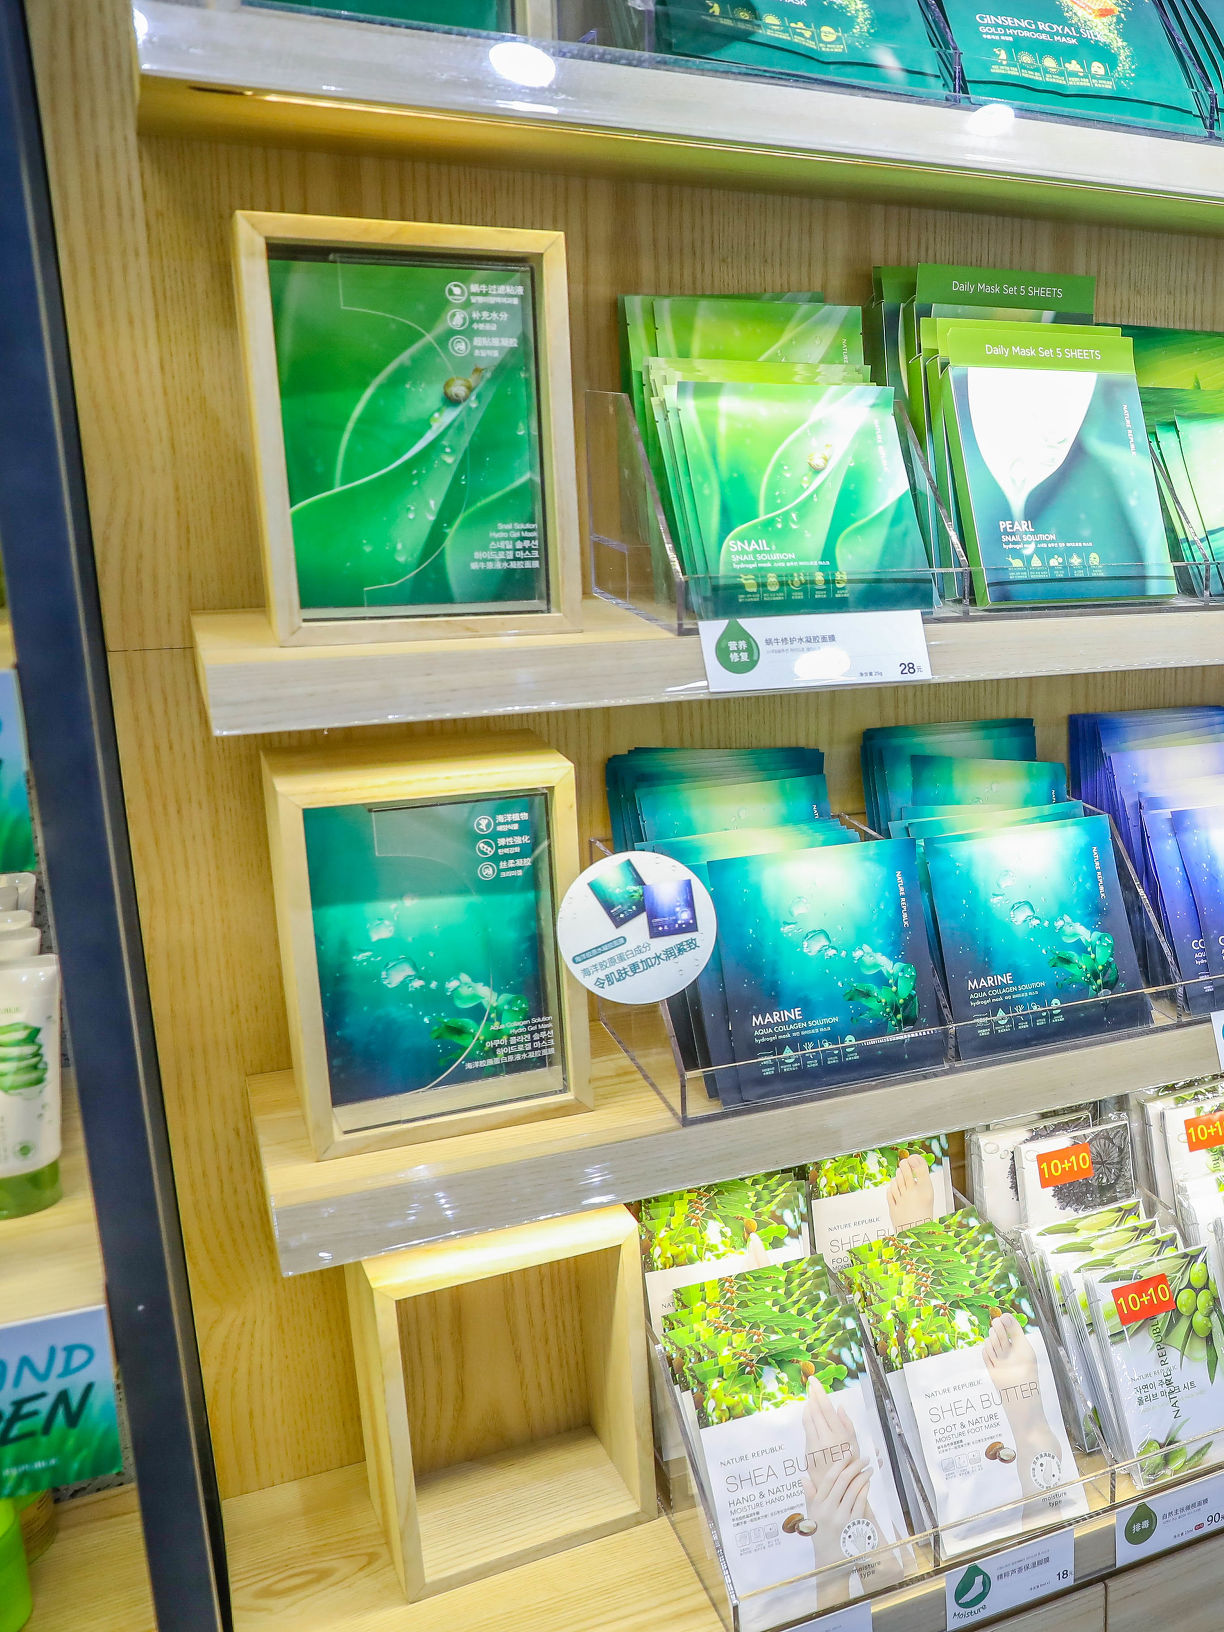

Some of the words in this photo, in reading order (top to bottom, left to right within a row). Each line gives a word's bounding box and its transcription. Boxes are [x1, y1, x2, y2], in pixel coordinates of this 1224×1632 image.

[976, 13, 1036, 31] GINSENG
[1037, 21, 1080, 37] ROYAL
[979, 26, 1005, 36] GOLD
[1006, 29, 1054, 42] HYDROGEL
[1054, 36, 1079, 46] MASK
[952, 281, 975, 294] Daily
[977, 283, 1001, 295] Mask
[1002, 284, 1018, 296] Set
[1020, 286, 1026, 296] 5
[1028, 286, 1063, 298] SHEETS
[985, 344, 1009, 357] Daily
[1012, 346, 1036, 358] Mask
[1038, 347, 1054, 358] Set
[1056, 348, 1063, 358] 5
[1064, 348, 1101, 360] SHEETS
[999, 520, 1035, 533] PEARL
[728, 539, 770, 553] SNAIL
[594, 937, 700, 989] 令肌肤更加水润紧致
[967, 972, 1013, 991] MARINE
[970, 990, 987, 1000] AQUA
[988, 985, 1018, 996] COLLAGEN
[1018, 981, 1046, 992] SOLUTION
[752, 1007, 803, 1027] MARINE
[754, 1026, 773, 1037] AQUA
[774, 1021, 807, 1033] COLLAGEN
[808, 1016, 839, 1027] SOLUTION
[1040, 1152, 1090, 1179] 10+10
[1117, 1283, 1171, 1315] 10+10
[0, 1381, 96, 1446] EN
[928, 1398, 976, 1424] SHEA
[980, 1380, 1040, 1411] BUTTER
[933, 1424, 959, 1437] FOOT
[960, 1421, 966, 1431] &
[968, 1412, 999, 1427] NATURE
[935, 1430, 966, 1445] MOISTURE
[967, 1425, 983, 1437] FOOT
[984, 1421, 1001, 1432] MASK
[719, 1453, 749, 1467] NATURE
[751, 1444, 785, 1460] REPUBLIC
[725, 1464, 779, 1494] SHEA
[783, 1441, 853, 1477] BUTTER
[728, 1492, 757, 1508] HAND
[759, 1490, 766, 1499] &
[767, 1479, 804, 1496] NATURE
[730, 1501, 764, 1516] MOISTURE
[765, 1495, 784, 1509] HAND
[785, 1489, 805, 1501] MASK
[952, 1604, 987, 1619] Moisture
